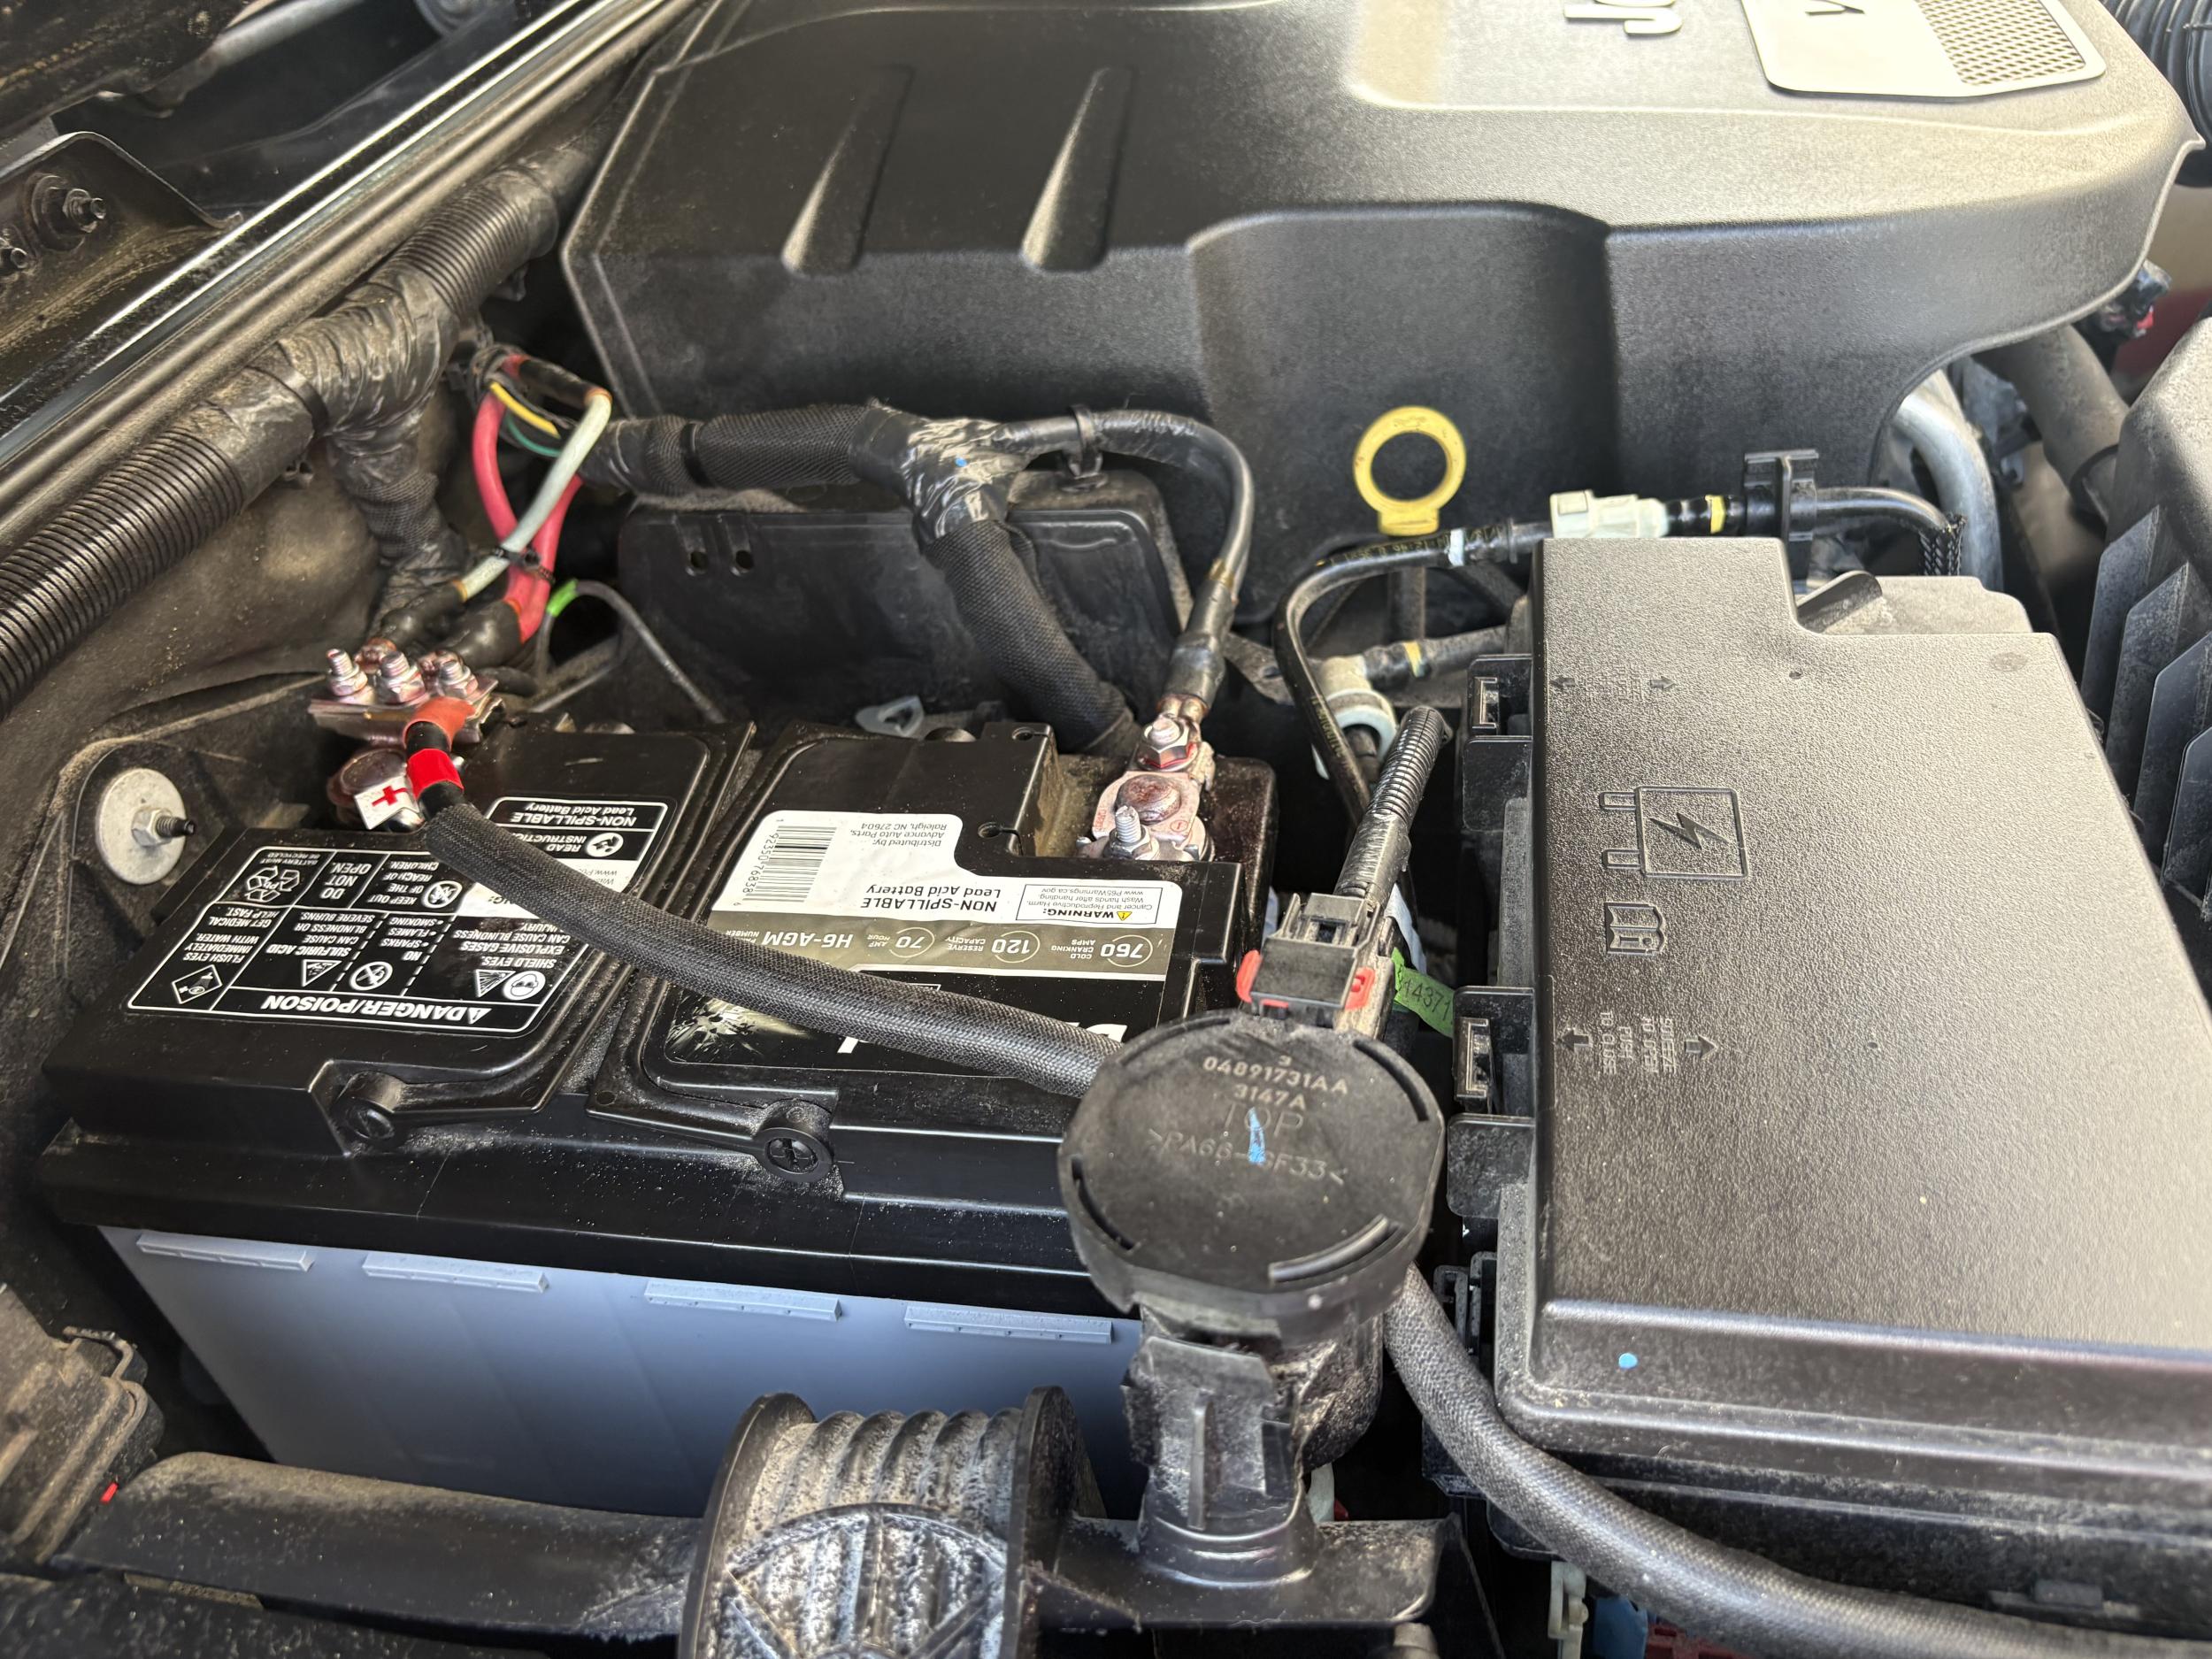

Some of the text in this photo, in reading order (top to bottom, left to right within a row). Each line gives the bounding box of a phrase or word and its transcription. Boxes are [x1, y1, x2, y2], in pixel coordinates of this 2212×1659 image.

[525, 802, 634, 817] Lead Acid Battery
[511, 811, 637, 827] NON-SPILLABLE
[910, 822, 948, 832] Raleigh,
[849, 829, 945, 840] Advance Auto Parts,
[545, 843, 581, 853] READ
[757, 832, 780, 861] 92350
[872, 837, 942, 848] Distributed by:
[331, 863, 372, 874] OPEN.
[389, 861, 440, 872] CHILDREN.
[324, 874, 357, 887] NOT
[382, 872, 433, 883] REACH OF
[742, 864, 764, 894] 76838
[263, 879, 280, 890] Pb
[388, 883, 424, 894] OF THE
[319, 887, 345, 900] DO
[865, 884, 1001, 898] Lead Acid Battery
[367, 895, 417, 905] KEEP OUT
[860, 896, 997, 913] NON-SPILLABLE
[227, 907, 280, 919] HELP FAST.
[301, 911, 375, 924] SEVERE BURNS.
[1042, 908, 1114, 918] WARNING:
[207, 916, 273, 928] GET MEDICAL
[388, 916, 438, 926] SMOKING
[294, 923, 368, 934] BLINDNESS OR
[388, 927, 431, 937] FLAMES
[196, 933, 260, 944] WITH WATER.
[303, 934, 359, 945] CAN CAUSE
[453, 929, 571, 944] CAN CAUSE BLINDNESS
[761, 931, 854, 949] H6-AGM
[895, 935, 926, 949] 70
[944, 936, 987, 945] CAPACITY
[184, 942, 253, 954] IMMEDIATELY
[380, 938, 422, 949] SPARKS
[459, 941, 565, 955] EXPLOSIVE GASES
[947, 943, 984, 952] RESERVE
[991, 939, 1032, 954] 120
[265, 943, 352, 957] SULFURIC ACID
[402, 951, 423, 961] NO
[1100, 943, 1144, 959] 760
[182, 952, 244, 964] FLUSH EYES
[480, 956, 557, 969] SHIELD EYES.
[260, 995, 468, 1021] DANGER/POISON
[1600, 1010, 1617, 1075] TO CLOSE
[1618, 1025, 1634, 1061] PUSH
[1641, 1017, 1659, 1073] TO OPEN
[1659, 1015, 1677, 1074] SQUEEZE
[1233, 1084, 1307, 1110] 3147A
